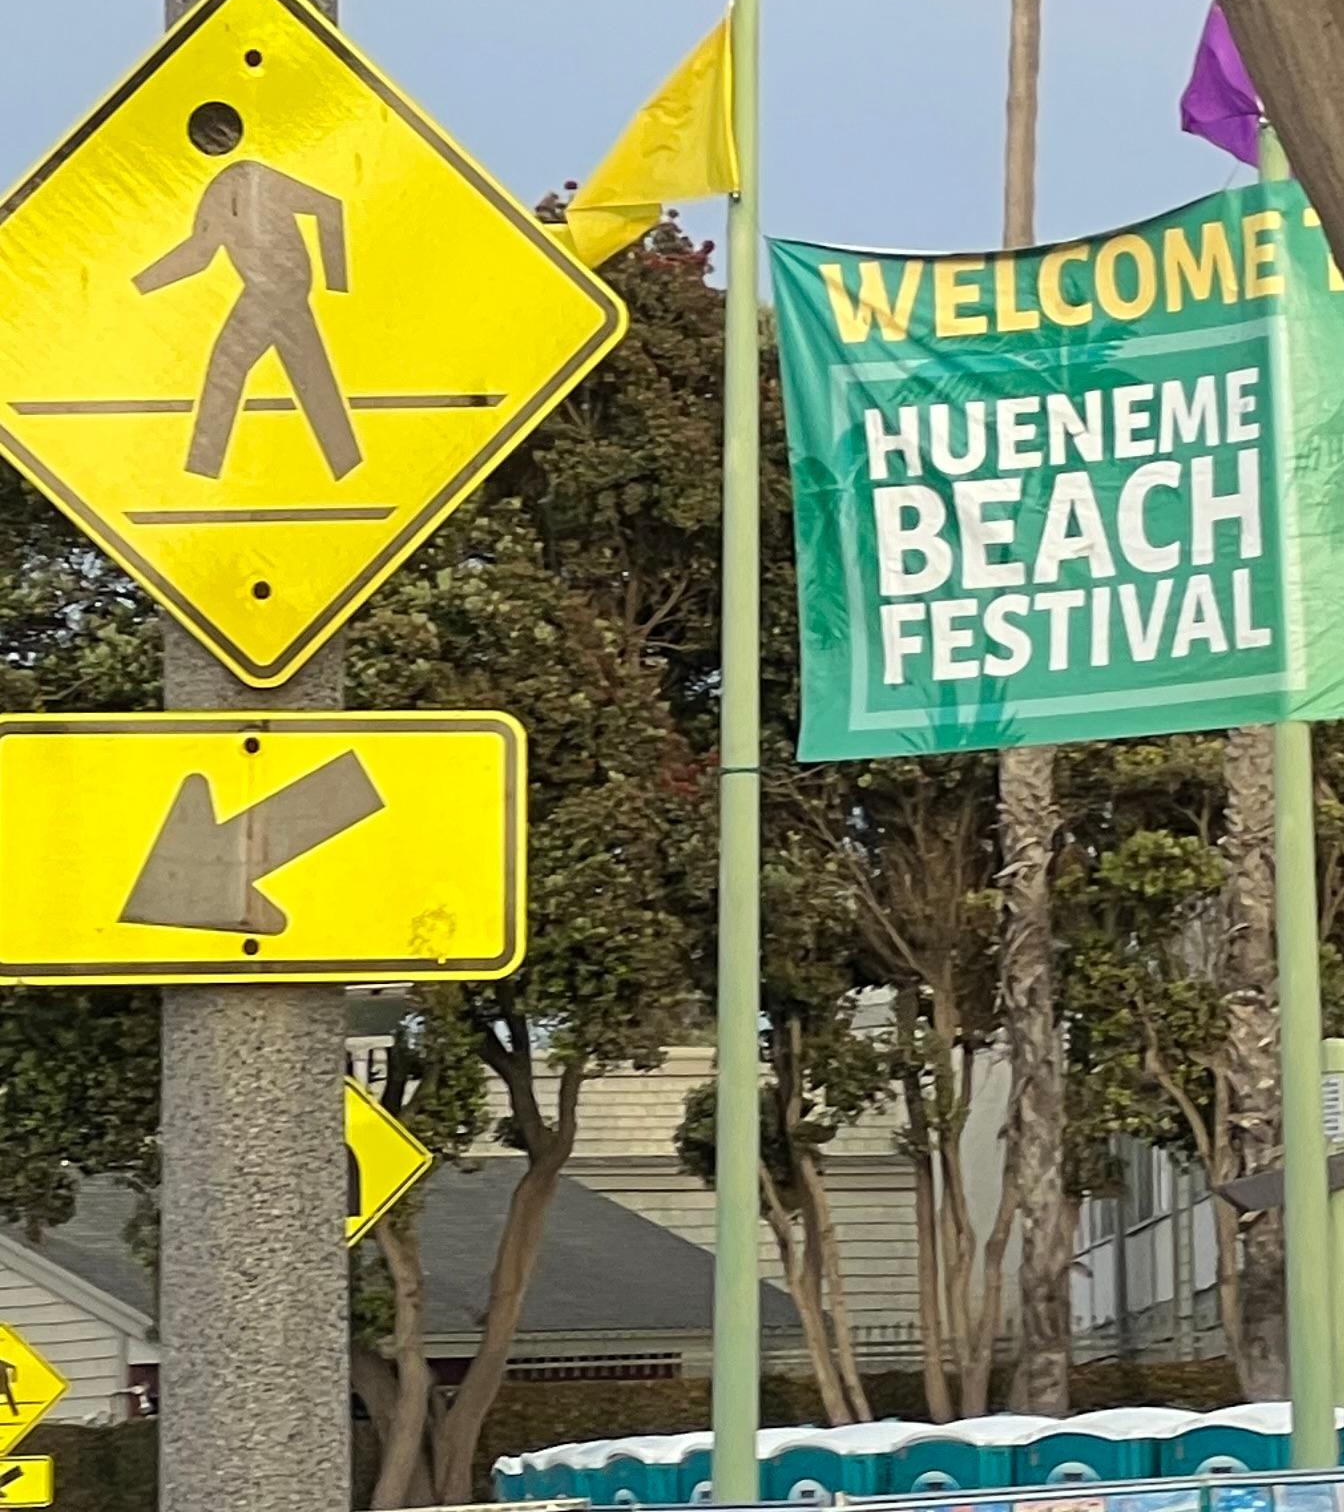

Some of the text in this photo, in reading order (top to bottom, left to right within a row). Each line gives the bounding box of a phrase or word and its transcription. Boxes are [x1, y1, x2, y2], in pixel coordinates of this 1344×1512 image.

[819, 210, 1286, 344] WELCOME
[864, 367, 1261, 479] HUENEME
[873, 448, 1262, 597] BEACH
[880, 568, 1272, 685] FESTIVAL
